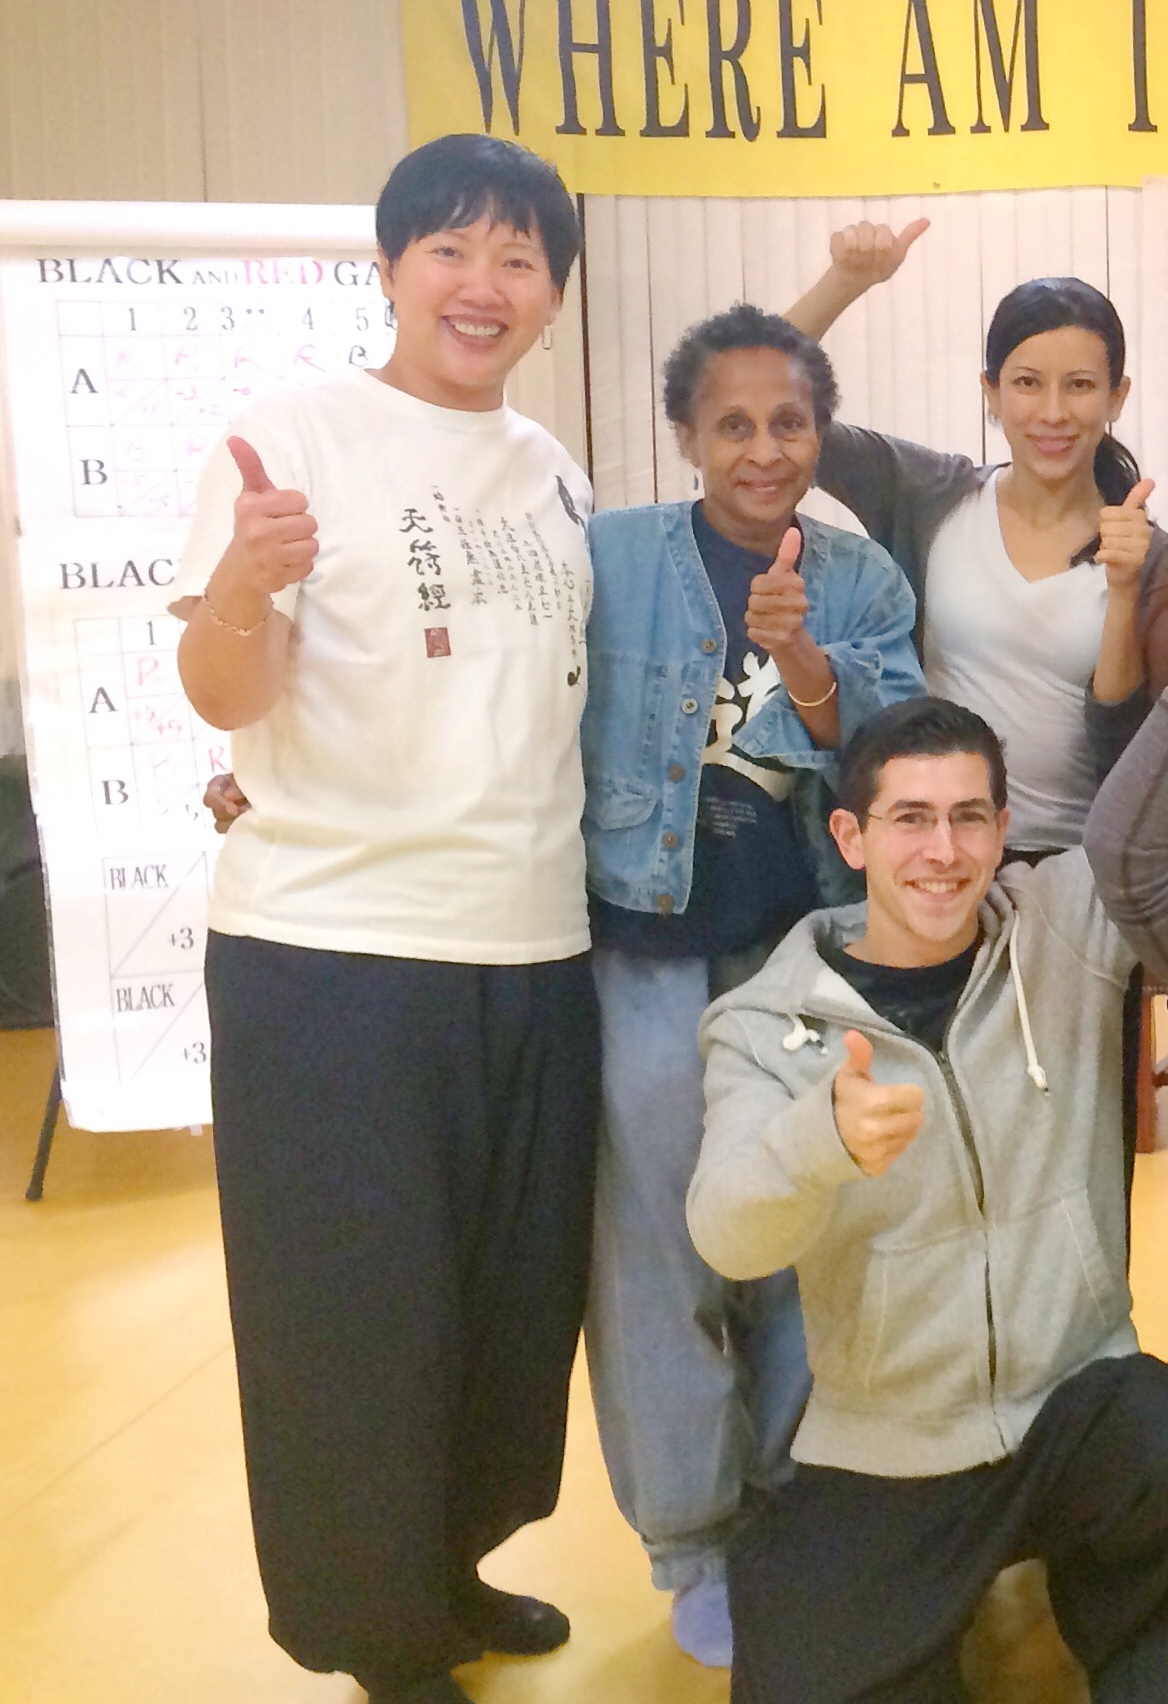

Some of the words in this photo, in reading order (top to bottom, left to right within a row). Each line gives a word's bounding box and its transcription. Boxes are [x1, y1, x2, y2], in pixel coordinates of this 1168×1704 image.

[461, 0, 828, 142] WHERE
[890, 0, 1051, 137] AM
[1127, 0, 1159, 133] I
[38, 257, 184, 285] BLACK
[191, 269, 239, 285] AND
[243, 259, 324, 285] RED
[333, 261, 380, 287] GA
[128, 307, 137, 331] 1
[183, 307, 198, 331] 2
[221, 306, 236, 331] 3
[301, 306, 315, 330] 4
[355, 307, 370, 332] 5
[70, 368, 99, 394] A
[80, 458, 109, 485] B
[59, 558, 180, 590] BLAC
[146, 620, 156, 646] 1
[89, 686, 118, 714] A
[101, 779, 129, 805] B
[109, 863, 169, 891] BLACK
[168, 927, 195, 951] +3
[116, 983, 176, 1013] BLACK
